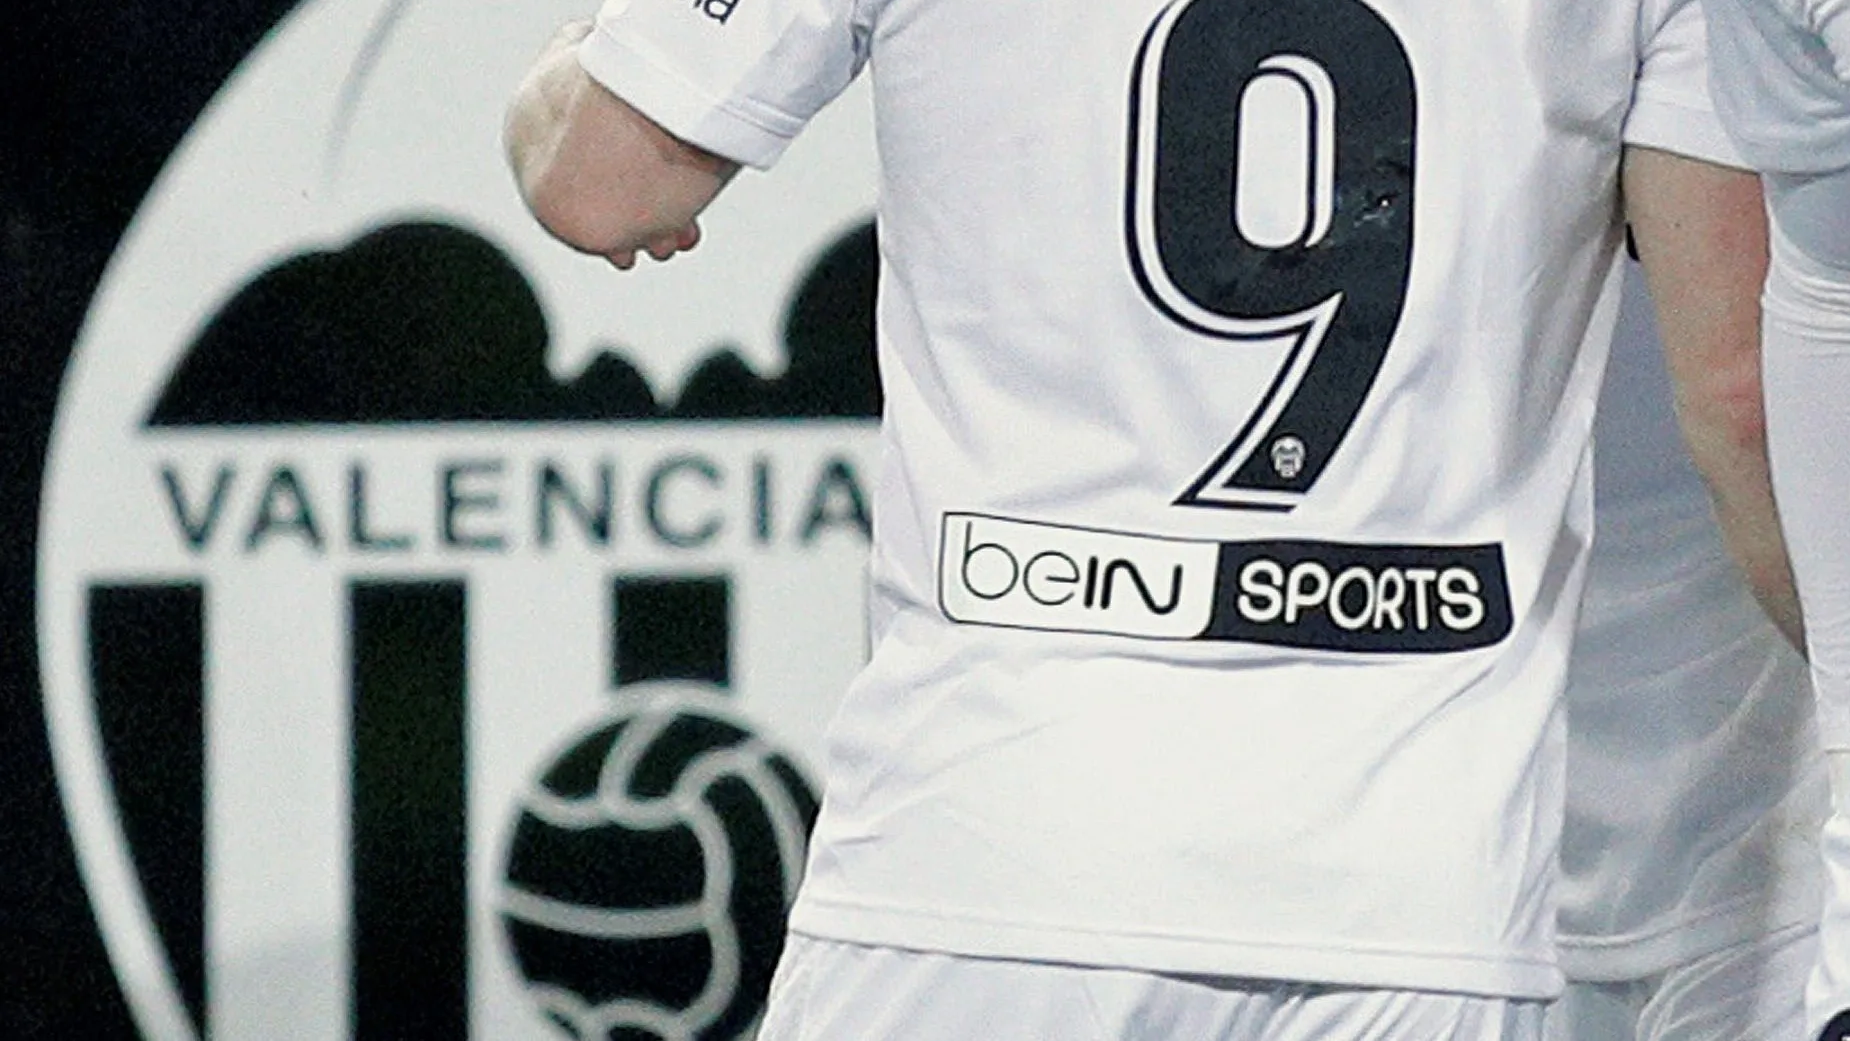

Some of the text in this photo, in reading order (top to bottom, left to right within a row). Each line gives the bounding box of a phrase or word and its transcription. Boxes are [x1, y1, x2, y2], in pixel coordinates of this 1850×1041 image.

[162, 457, 873, 552] VALENCIA
[961, 521, 1486, 631] beIN SPORTS
